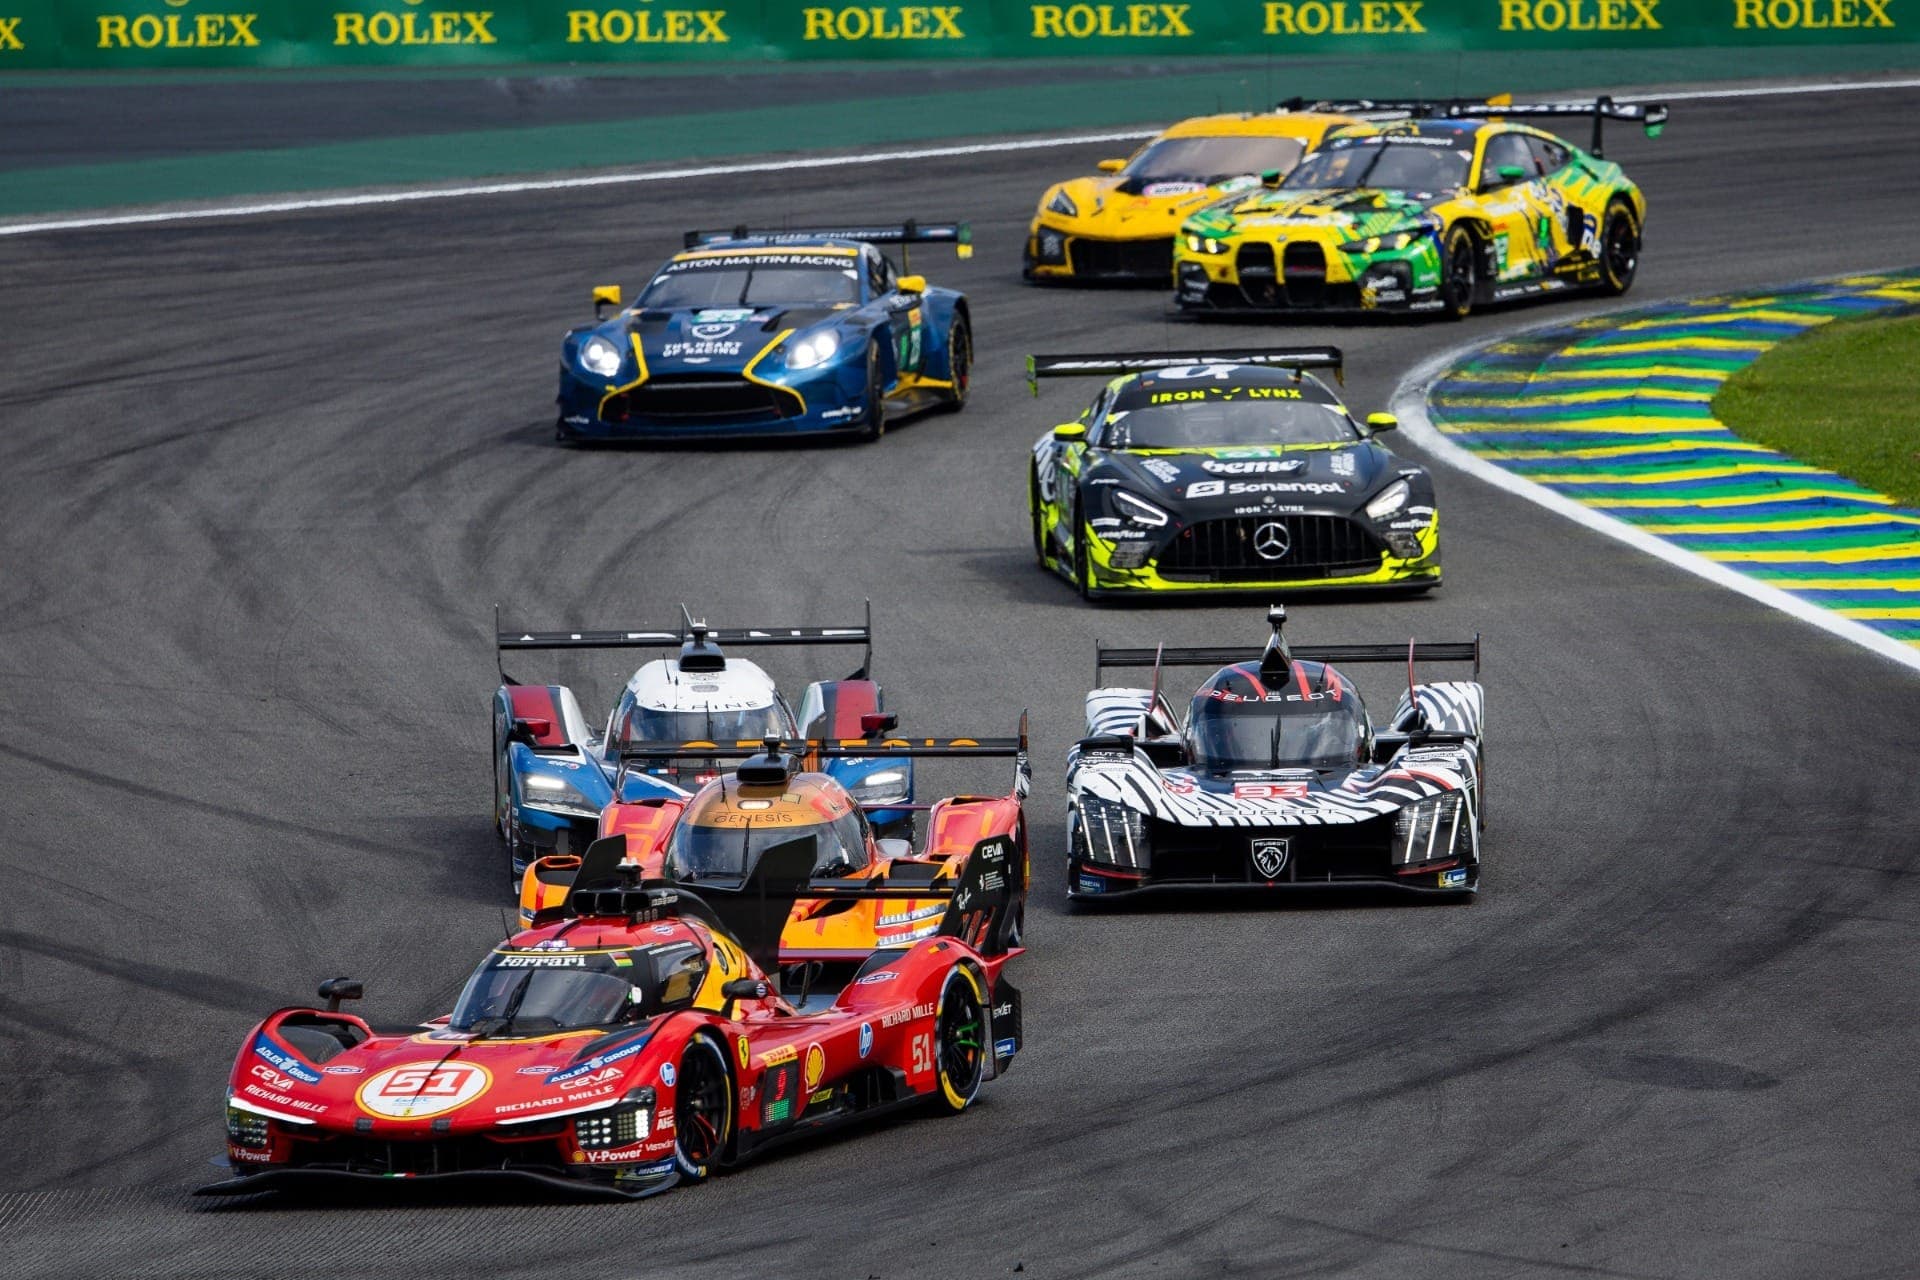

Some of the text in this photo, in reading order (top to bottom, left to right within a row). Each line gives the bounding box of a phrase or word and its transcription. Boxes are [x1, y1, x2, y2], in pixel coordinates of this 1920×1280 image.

[568, 10, 728, 43] ROLEX
[804, 7, 963, 40] ROLEX
[1032, 4, 1191, 38] ROLEX
[1265, 2, 1424, 34] ROLEX
[1501, 0, 1660, 31] ROLEX
[1735, 0, 1894, 29] ROLEX
[99, 15, 259, 47] ROLEX
[335, 12, 495, 45] ROLEX
[667, 255, 854, 272] ASTON MARTIN RACING
[694, 341, 743, 349] HEART
[1151, 386, 1302, 403] IRON LYNX
[1229, 482, 1345, 494] Sonangol
[1210, 689, 1337, 702] PEUGEOT
[1238, 784, 1304, 799] 93
[714, 813, 793, 824] GENESIS
[1199, 808, 1337, 816] PEUGEOT
[497, 954, 587, 967] Ferrari
[881, 1002, 935, 1029] RICHARD MILLE
[256, 1046, 283, 1065] ADLER
[287, 1067, 319, 1082] GROUP
[550, 1067, 590, 1083] ADLER
[604, 1044, 642, 1063] GROUP
[912, 1033, 932, 1074] 51
[385, 1071, 460, 1093] 51
[244, 1084, 293, 1105] RICHARD
[289, 1100, 328, 1113] MILLE
[495, 1085, 615, 1113] RICHARD MILLE
[233, 1147, 272, 1162] V-Power
[587, 1149, 642, 1163] V-Power
